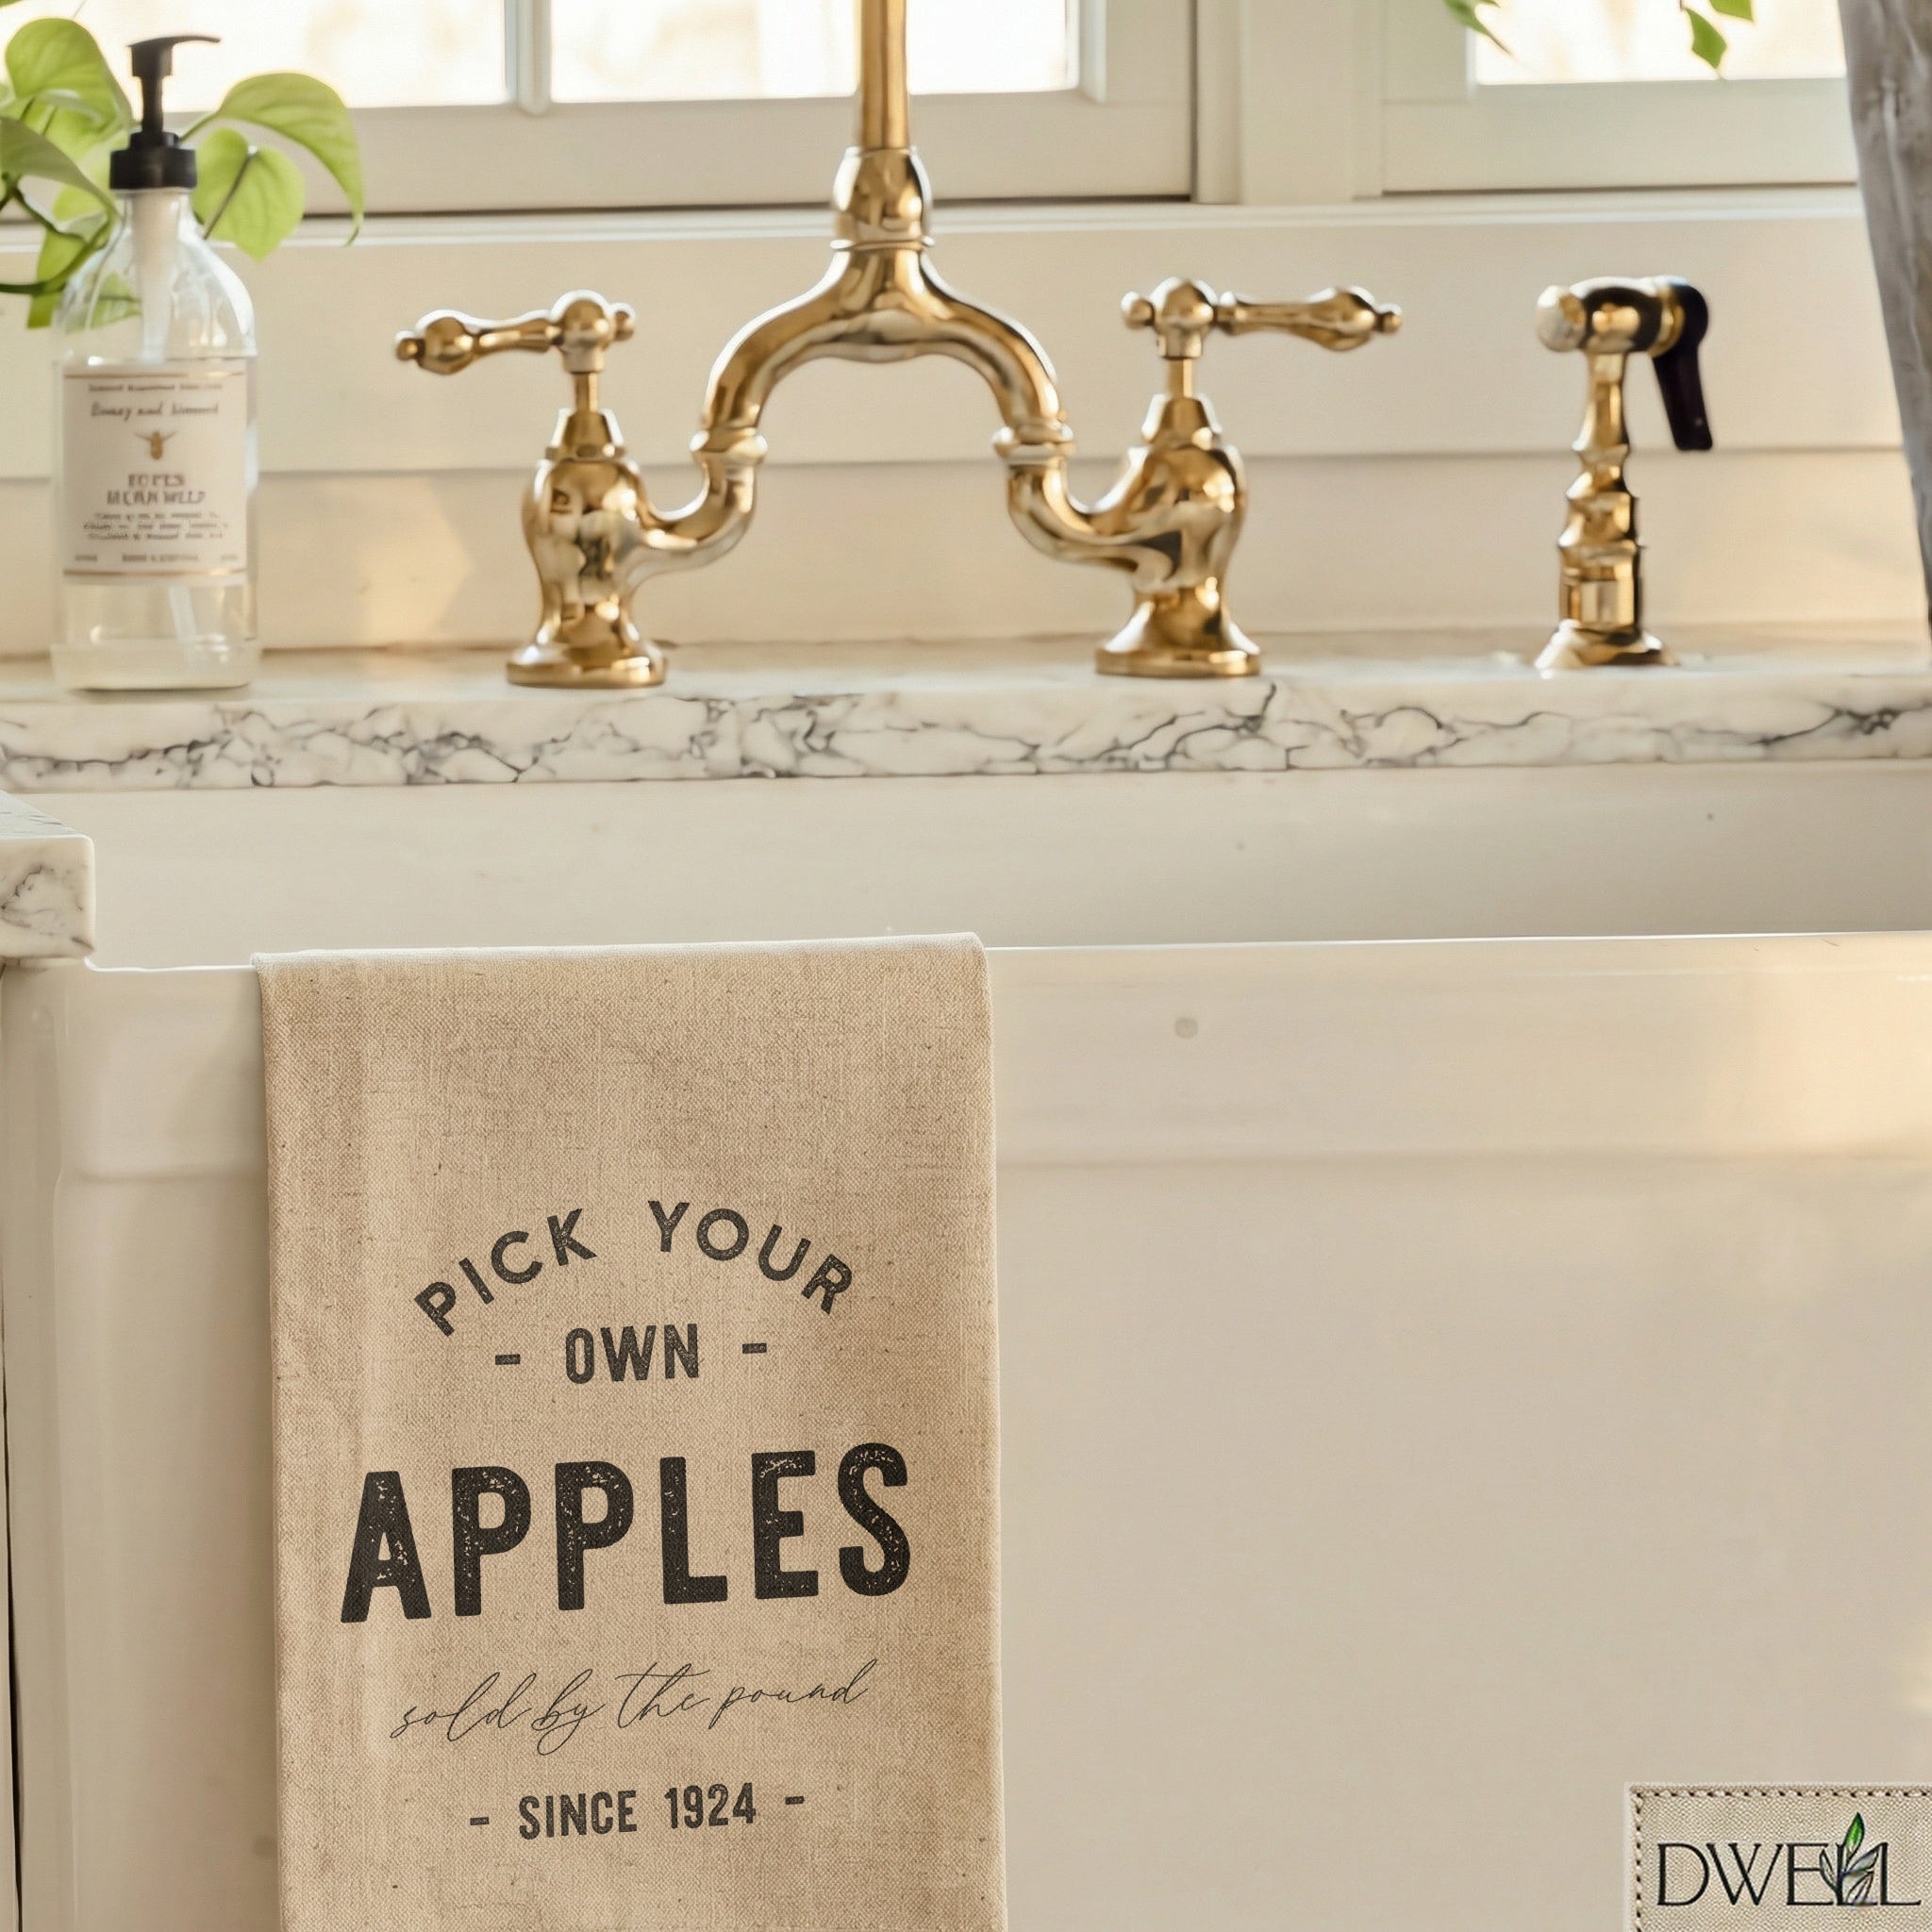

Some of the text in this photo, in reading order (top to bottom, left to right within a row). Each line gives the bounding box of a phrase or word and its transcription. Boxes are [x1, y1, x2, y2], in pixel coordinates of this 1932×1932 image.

[413, 1200, 854, 1338] PICK YOUR
[565, 1324, 701, 1385] OWN
[340, 1441, 911, 1624] APPLES
[390, 1658, 877, 1756] sold by the pound
[518, 1789, 638, 1840] SINCE
[664, 1782, 758, 1830] 1924
